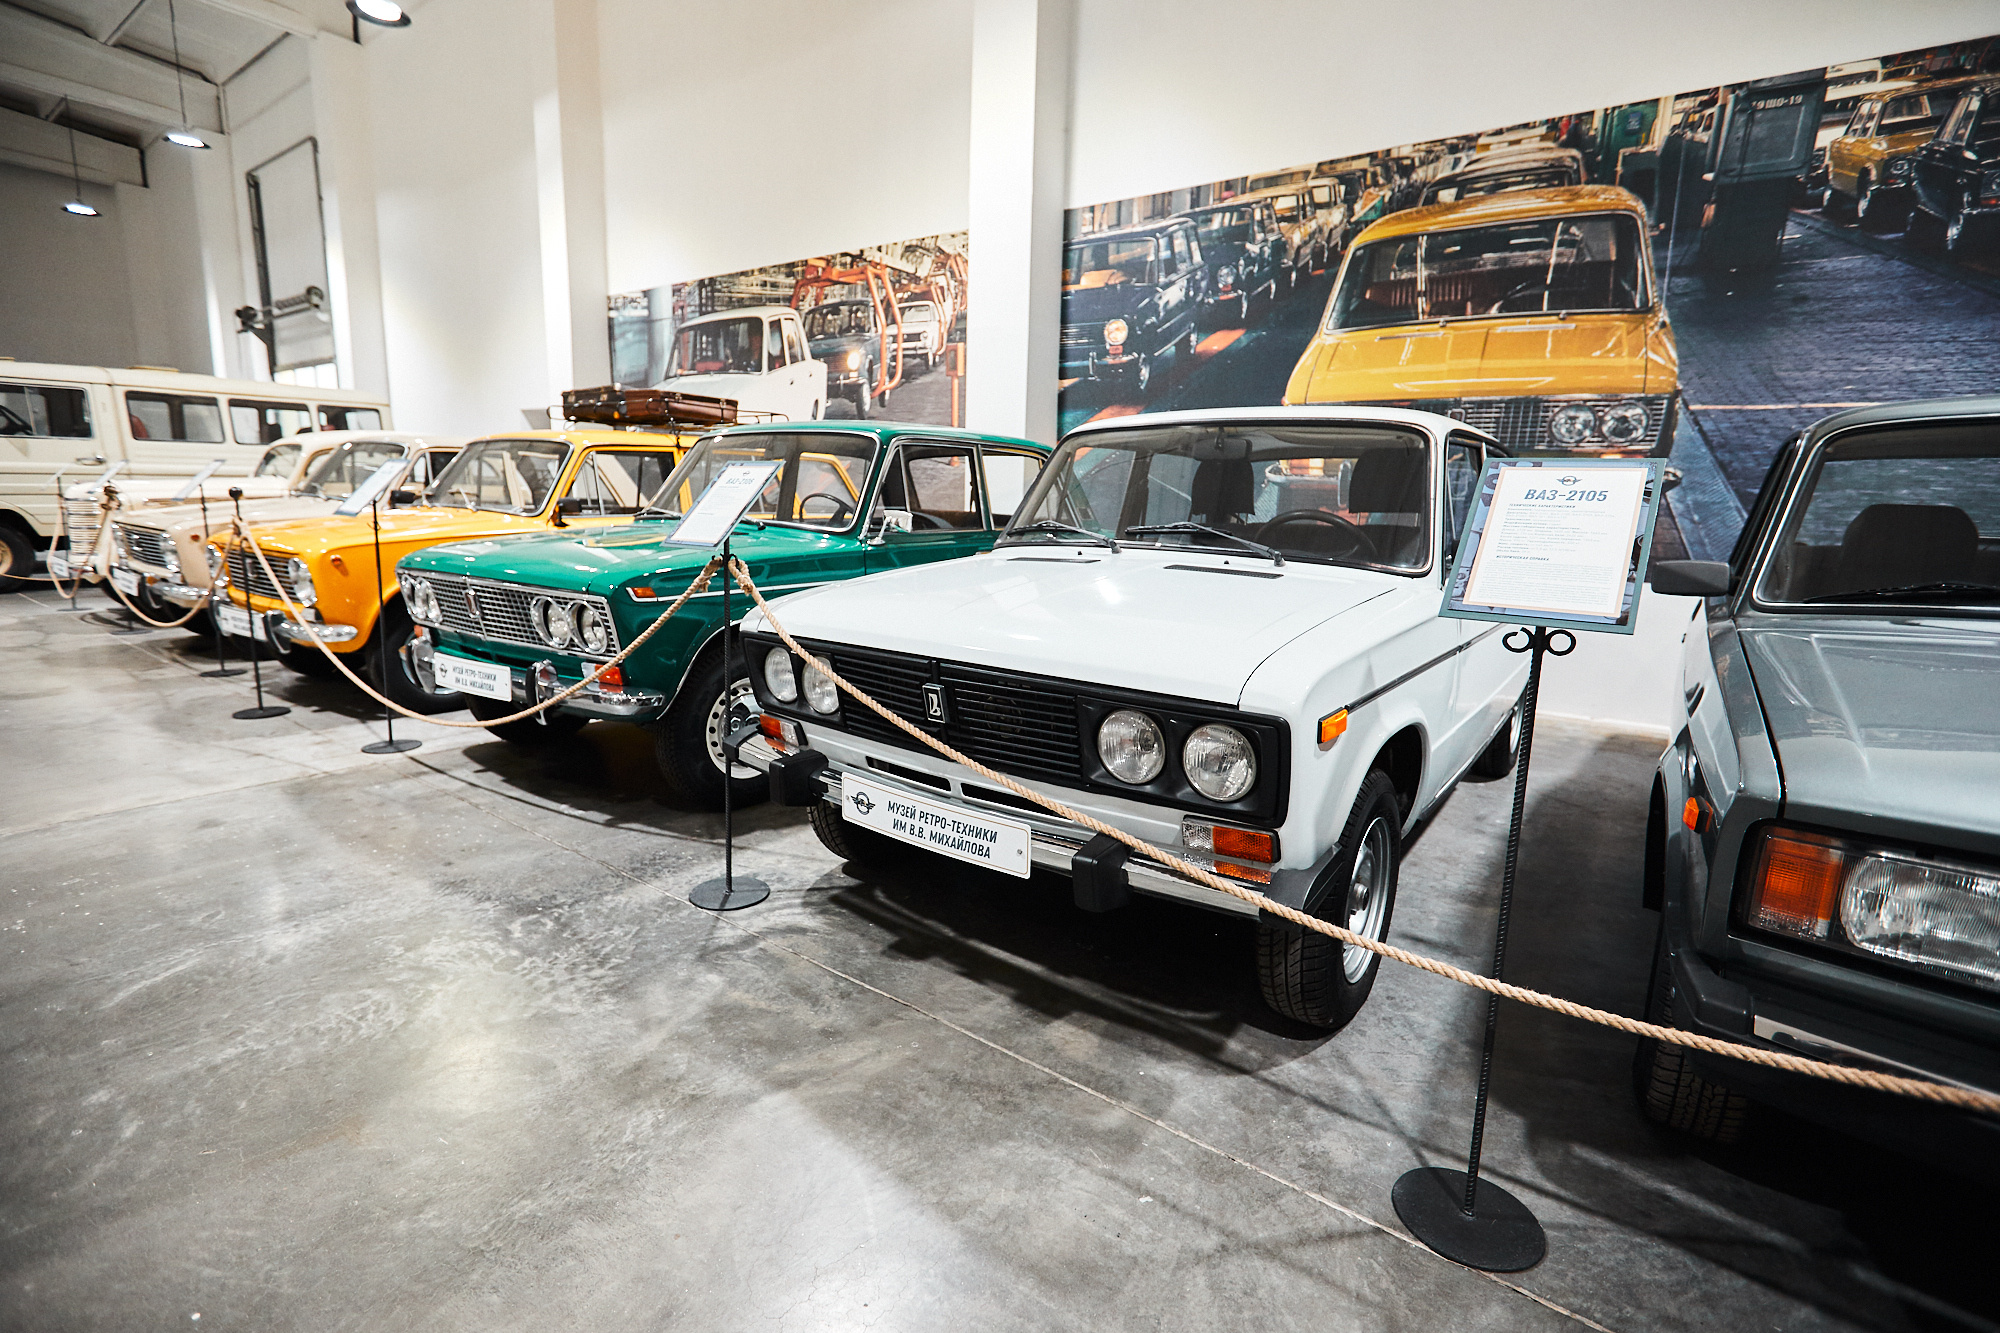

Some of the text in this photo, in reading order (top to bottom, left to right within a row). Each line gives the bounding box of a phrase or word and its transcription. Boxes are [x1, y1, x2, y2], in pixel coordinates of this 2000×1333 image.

[1524, 489, 1609, 502] ВАЗ-2105
[887, 800, 998, 844] МУЗЕЙ РЕТРО-ТЕХНИКИ
[892, 818, 991, 859] ИМ В.В. МИХАЙЛОВА
